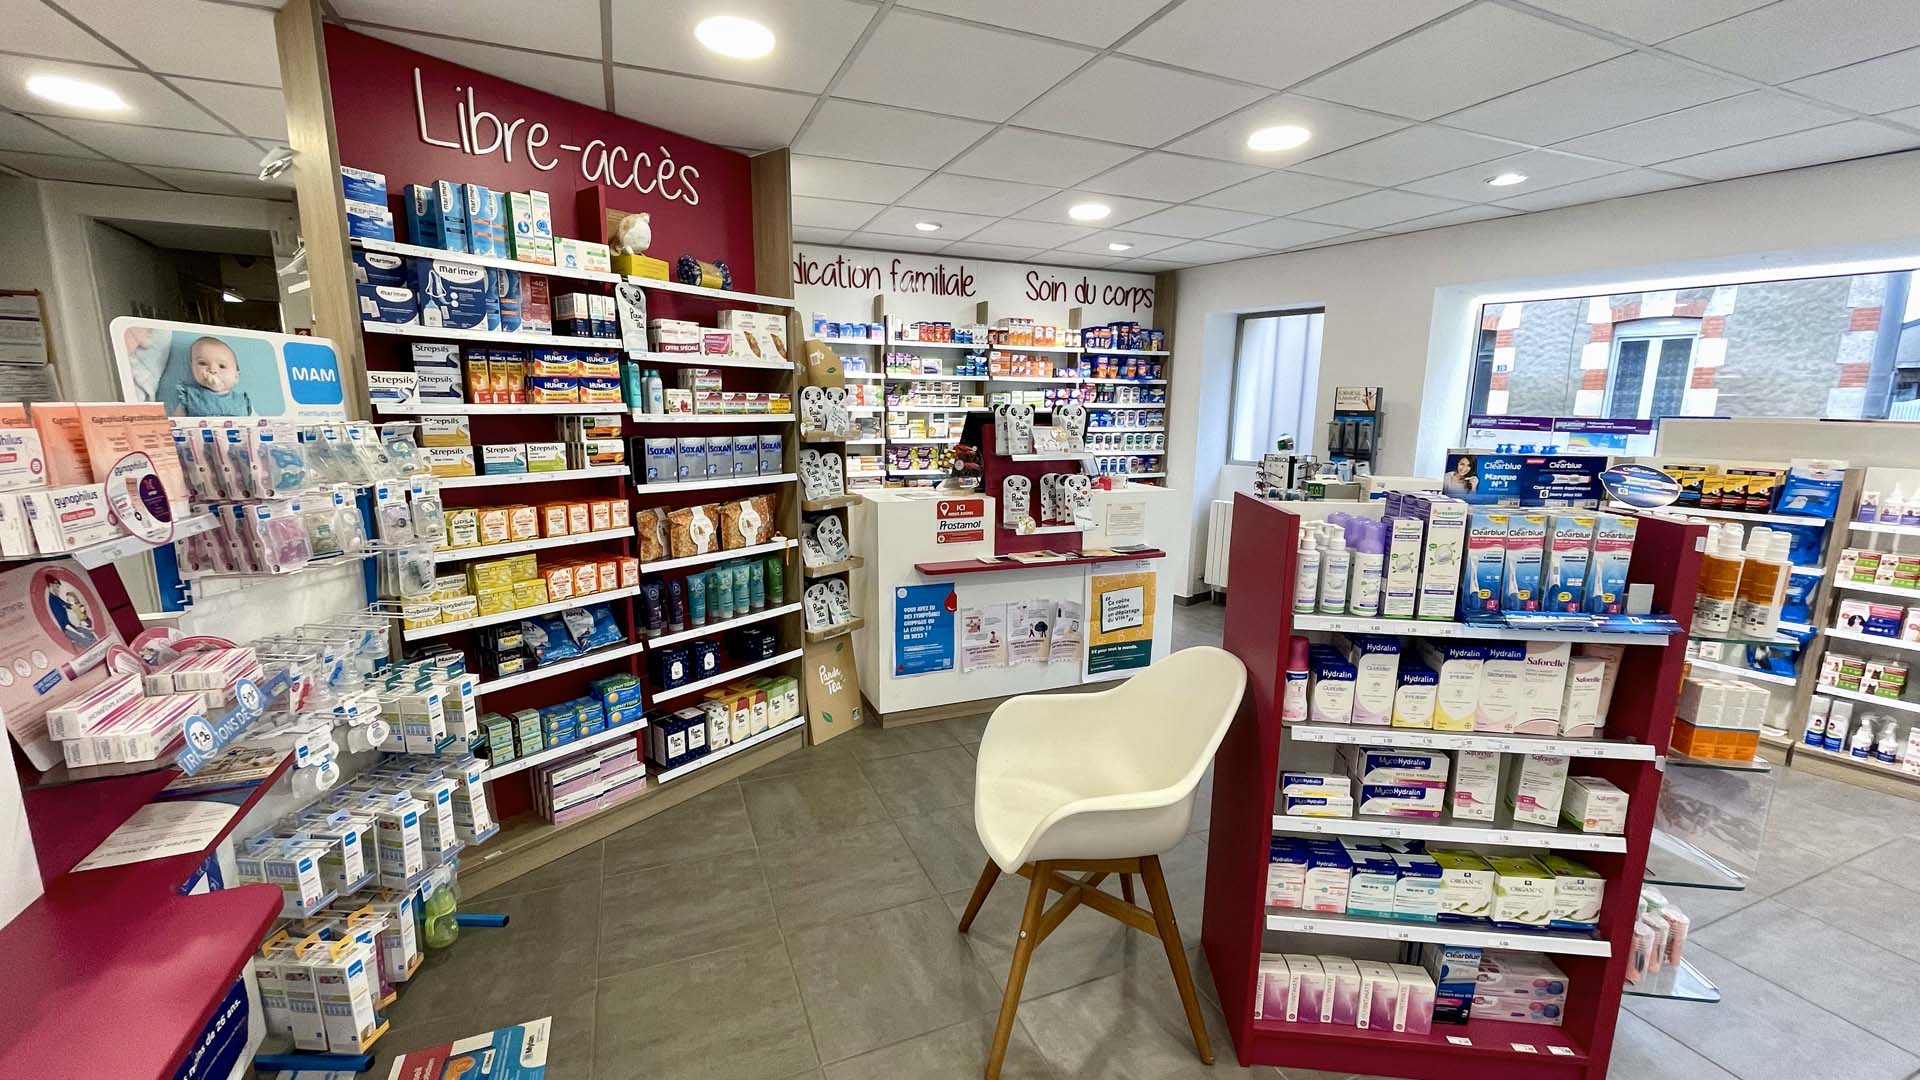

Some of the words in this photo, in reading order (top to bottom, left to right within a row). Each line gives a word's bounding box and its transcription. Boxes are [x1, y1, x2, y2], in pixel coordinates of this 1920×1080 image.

[413, 66, 702, 206] Libre-accès
[438, 263, 479, 277] marimer
[890, 258, 977, 298] familiale
[1025, 270, 1068, 302] Soin
[1074, 275, 1097, 305] du
[1102, 284, 1155, 314] corps
[414, 344, 450, 354] Strepsils
[543, 354, 568, 363] HUMEX
[586, 355, 610, 364] HUMEX
[291, 366, 336, 382] MAM
[418, 374, 453, 384] Strepsils
[370, 374, 415, 385] Strepsils
[544, 381, 569, 390] HUMEX
[589, 381, 612, 390] HUMEX
[429, 448, 465, 457] Strepsils
[485, 447, 518, 455] Strepsils
[529, 445, 559, 453] Strepsils
[1483, 460, 1522, 471] Clearblue
[1548, 460, 1583, 469] Clearblue
[1484, 473, 1518, 482] Marque
[54, 490, 98, 509] gynophilus
[939, 520, 982, 531] Prostamol
[1471, 528, 1507, 537] Clearblue
[1509, 528, 1544, 537] Clearblue
[1556, 530, 1592, 539] Clearblue
[1599, 530, 1634, 540] Clearblue
[1366, 643, 1397, 653] Hydralin
[1449, 648, 1481, 658] Hydralin
[1489, 649, 1522, 659] Hydralin
[1526, 655, 1567, 668] Saforelle
[818, 664, 842, 685] Panda
[1322, 669, 1353, 679] Hydralin
[1403, 674, 1434, 683] Hydralin
[824, 679, 843, 695] Tea
[1379, 756, 1426, 767] MycoHydralin
[1375, 786, 1421, 797] MycoHydralin
[1445, 951, 1481, 960] Clearblue
[215, 1014, 226, 1033] 26
